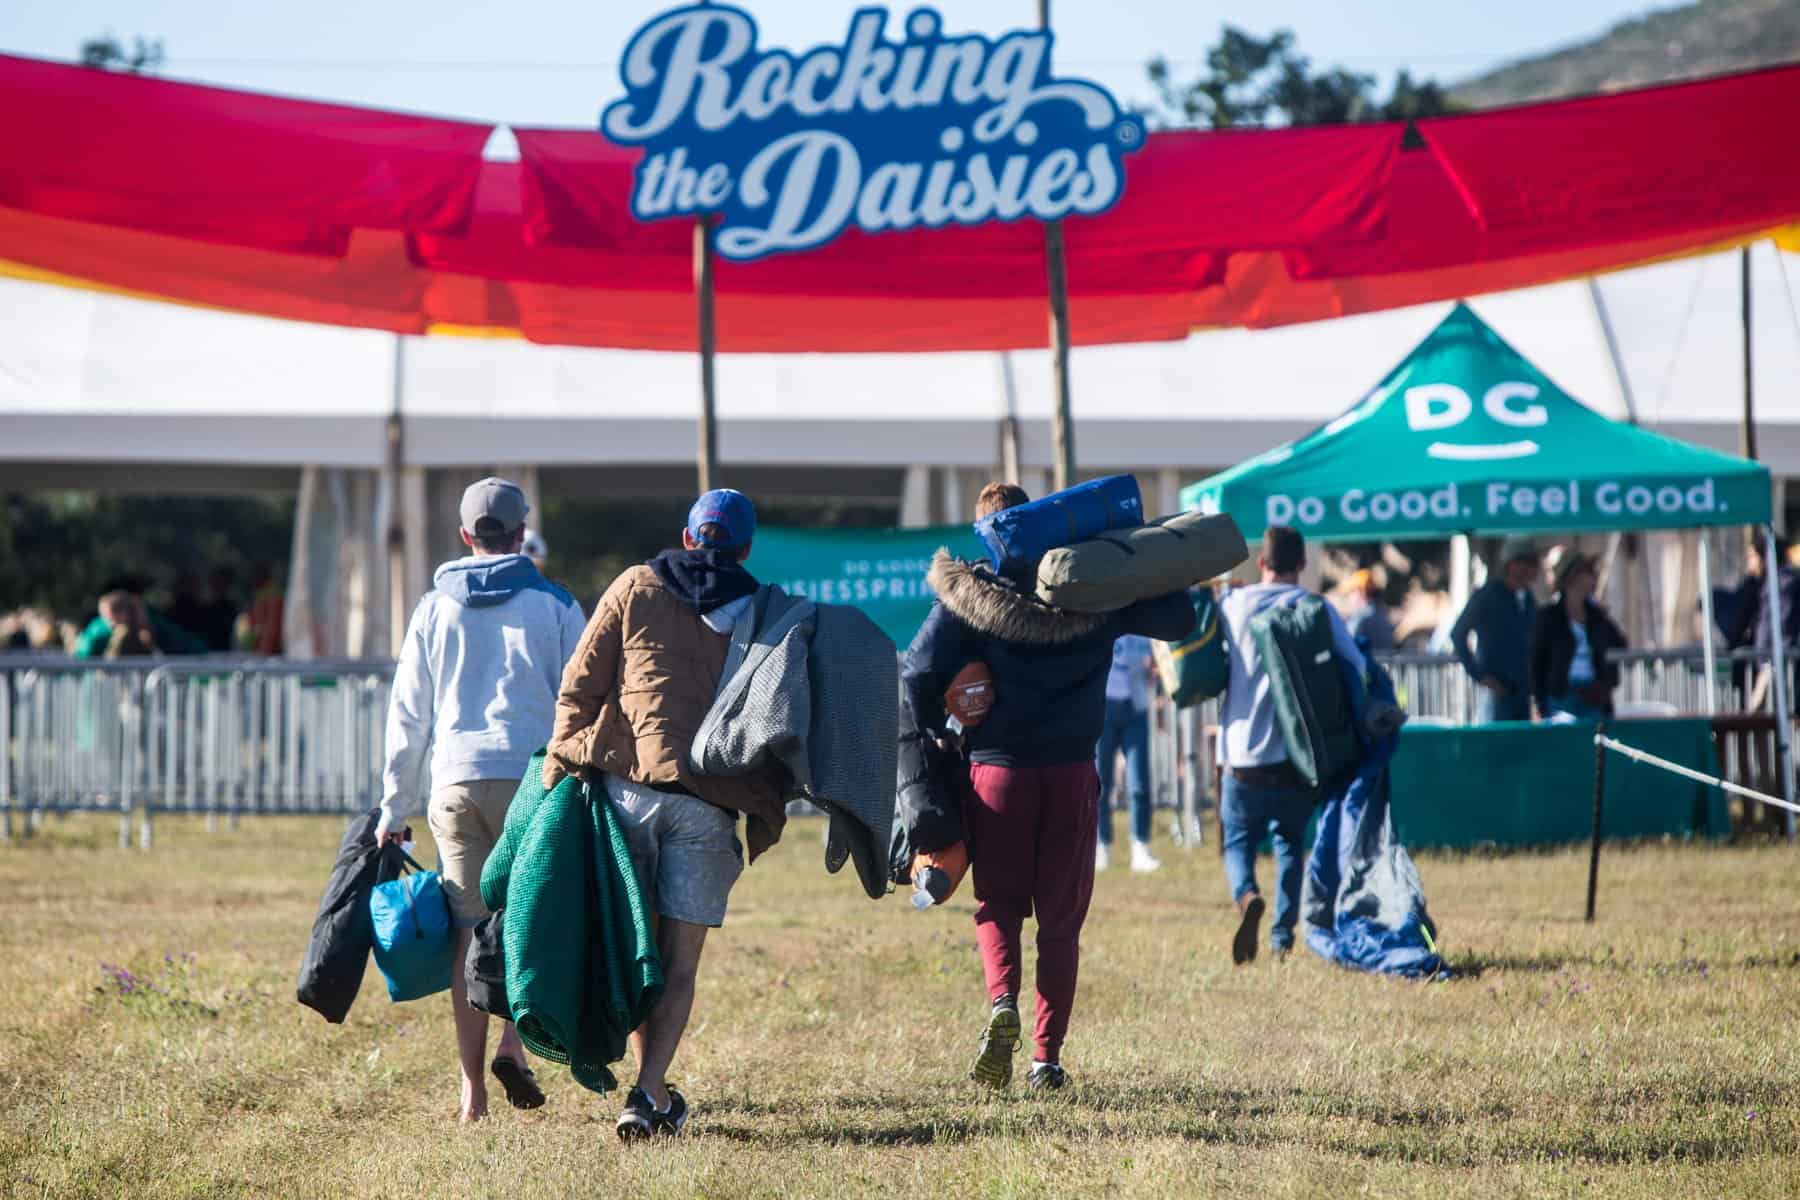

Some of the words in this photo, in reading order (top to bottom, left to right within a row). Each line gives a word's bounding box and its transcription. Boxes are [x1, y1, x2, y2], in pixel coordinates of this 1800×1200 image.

[604, 6, 1115, 142] Rocking
[639, 148, 732, 213] the
[716, 121, 1117, 257] Daisies
[1405, 382, 1548, 430] DG
[1265, 494, 1325, 527] Do
[1340, 484, 1471, 523] Good.
[1486, 482, 1579, 515] Feel
[1594, 477, 1728, 514] Good.
